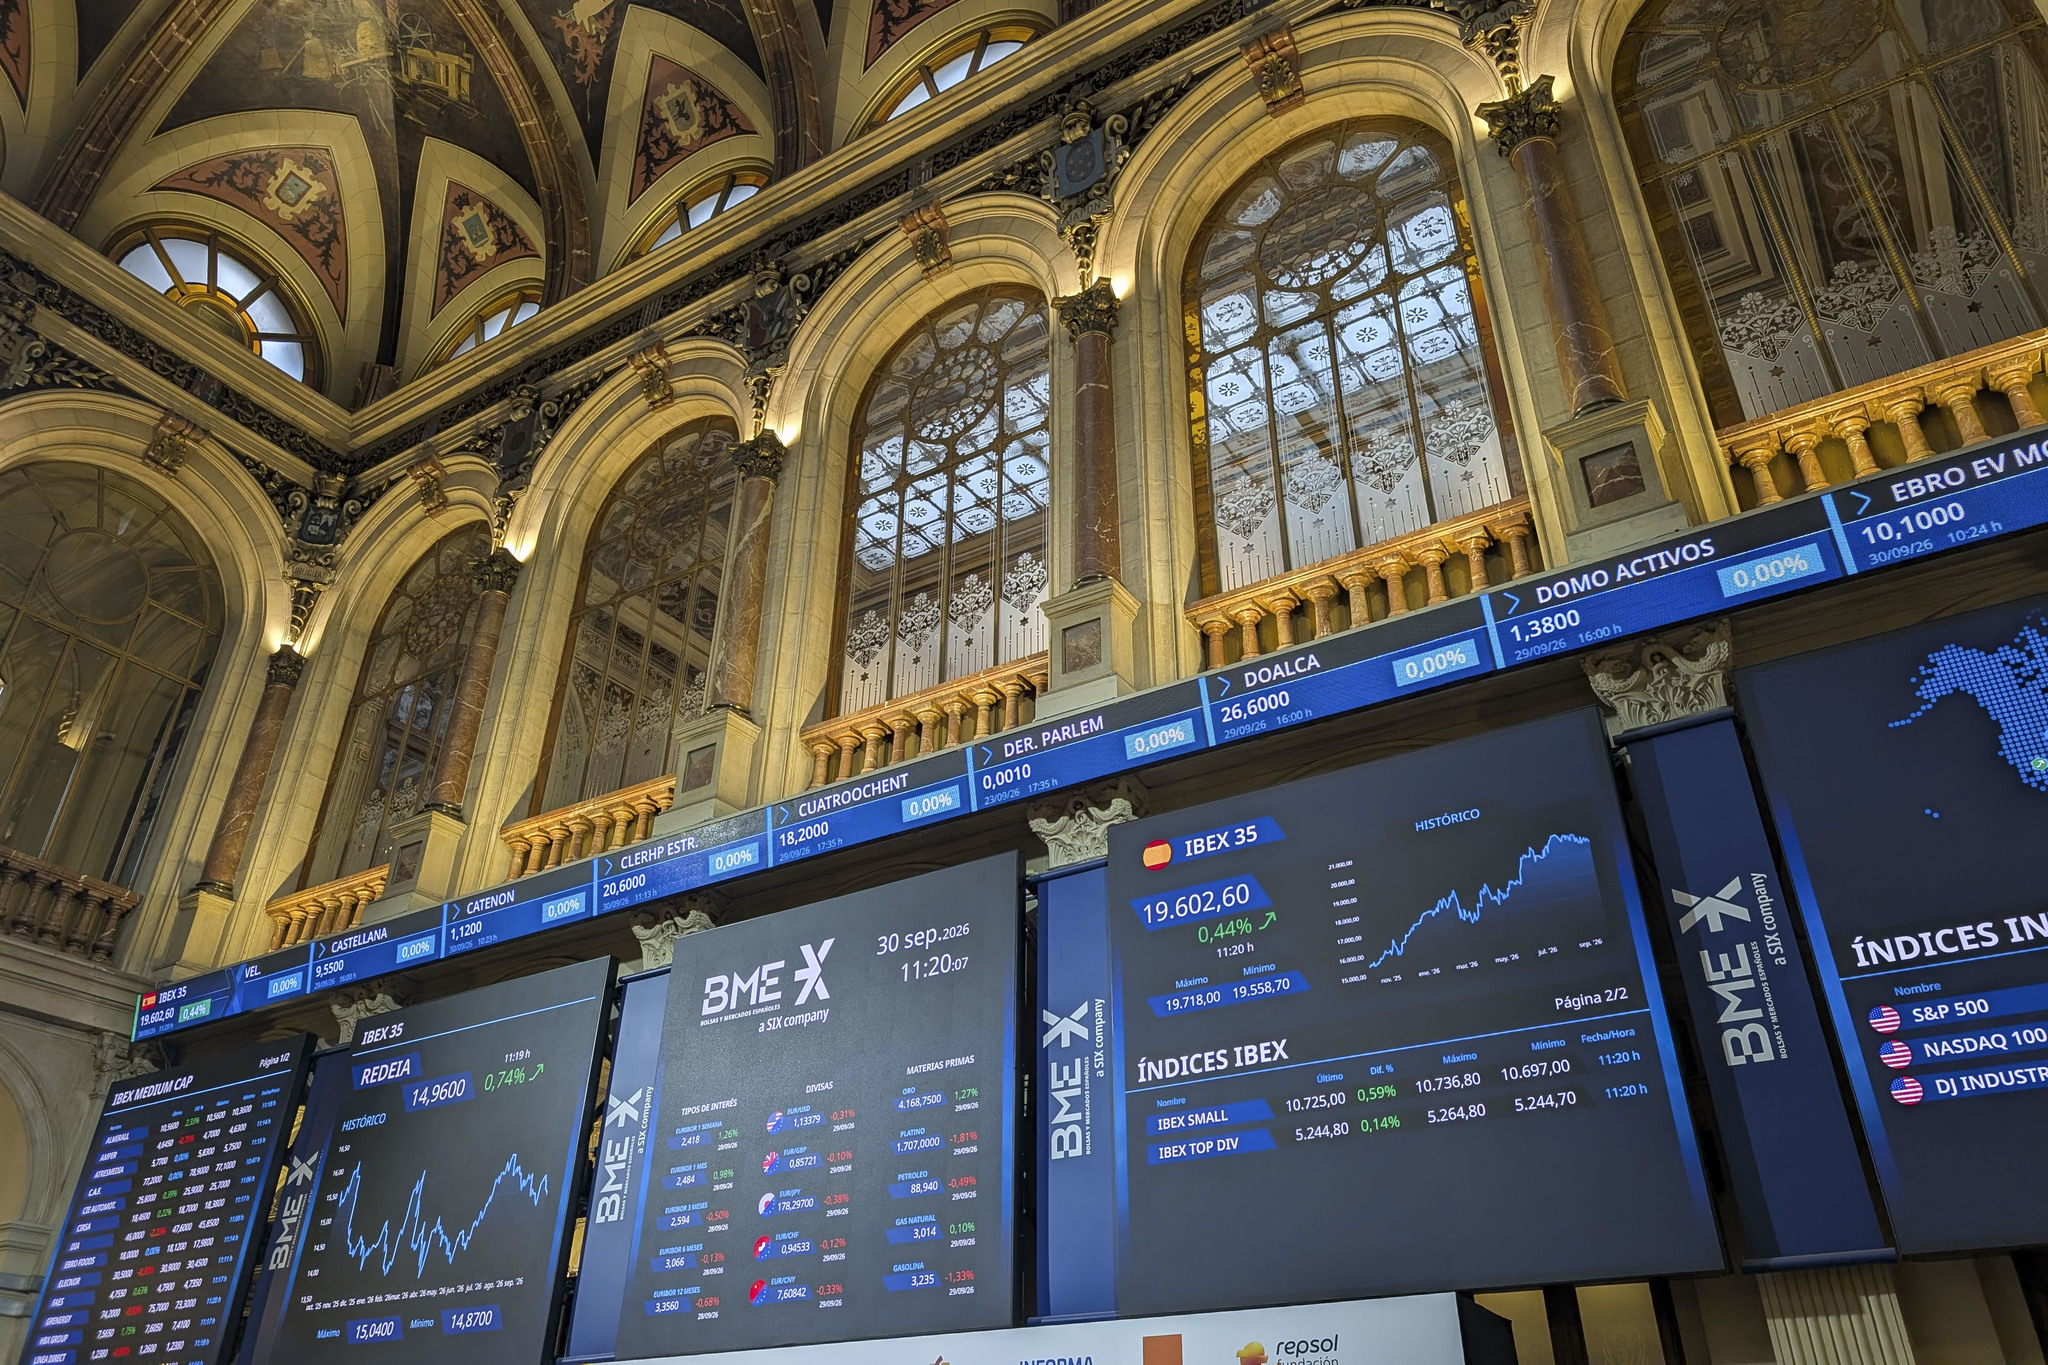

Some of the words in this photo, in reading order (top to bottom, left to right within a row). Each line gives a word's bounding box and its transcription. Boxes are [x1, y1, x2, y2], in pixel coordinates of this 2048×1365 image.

[1890, 468, 1966, 504] EBRO
[1972, 453, 2005, 479] EV
[1861, 502, 1965, 546] 10,1000
[1868, 538, 1934, 566] 30/09/26
[1947, 525, 1987, 545] 10:24
[1991, 521, 2003, 534] h
[1536, 570, 1610, 604] DOMO
[1614, 538, 1715, 582] ACTIVOS
[1732, 553, 1808, 588] 0,00%
[1510, 608, 1581, 643] 1,3800
[1514, 638, 1566, 661] 29/09/26
[1578, 626, 1610, 643] 16:00
[1244, 654, 1321, 688] DOALCA
[1404, 648, 1466, 680] 0,00%
[1220, 691, 1290, 723] 26,6000
[1224, 720, 1267, 740] 29/09/26
[1276, 710, 1303, 726] 16:00
[1004, 734, 1038, 758] DER.
[1041, 716, 1104, 748] PARLEM
[1134, 726, 1185, 753] 0,00%
[982, 764, 1032, 791] 0,0010
[798, 773, 910, 818] CUATROOCHENT
[910, 792, 952, 817] 0,00%
[984, 789, 1020, 806] 23/09/26
[1028, 781, 1049, 793] 17:35
[1414, 808, 1480, 832] HISTÓRICO
[779, 821, 829, 847] 18,2000
[1184, 831, 1230, 856] IBEX
[1234, 825, 1258, 845] 35
[620, 844, 664, 870] CLERHP
[668, 836, 698, 858] ESTR.
[715, 848, 752, 870] 0,00%
[603, 874, 646, 897] 20,6000
[466, 890, 515, 915] CATENON
[548, 898, 580, 918] 0,00%
[1143, 883, 1250, 924] 19.602,60
[1751, 872, 1776, 932] company
[331, 927, 388, 954] CASTELLANA
[450, 921, 482, 940] 1,1200
[1198, 917, 1252, 944] 0,44%
[402, 941, 430, 959] 0,00%
[876, 934, 899, 956] 30
[1216, 944, 1245, 958] 11:20
[1764, 932, 1784, 955] SIX
[1851, 921, 1998, 968] ÍNDICES
[316, 960, 344, 978] 9,5500
[901, 954, 968, 982] 11:20:07
[1242, 962, 1276, 976] Mínimo
[1751, 941, 1768, 980] ESPAÑOLES
[1775, 957, 1787, 966] a
[245, 966, 261, 978] VEL.
[1175, 975, 1208, 988] Máximo
[158, 989, 177, 1004] IBEX
[177, 986, 187, 999] 35
[272, 977, 298, 994] 0,00%
[702, 960, 785, 1016] BME
[1232, 977, 1290, 999] 19.558,70
[1894, 981, 1942, 996] Nombre
[1165, 990, 1221, 1012] 19.718,00
[1554, 991, 1602, 1010] Página
[1604, 987, 1628, 1002] 2/2
[1700, 943, 1775, 1066] BME
[1762, 981, 1778, 1023] MERCADOS
[140, 1008, 174, 1026] 19.602,60
[182, 1004, 206, 1020] 0,44%
[700, 1017, 718, 1026] BOLSAS
[724, 1010, 751, 1022] MERCADOS
[752, 1004, 780, 1015] ESPAÑOLES
[758, 1022, 764, 1032] a
[766, 1018, 782, 1031] SIX
[784, 1007, 829, 1028] company
[1912, 1004, 1950, 1023] S&P
[1954, 999, 1989, 1016] 500
[361, 1026, 388, 1044] IBEX
[388, 1023, 404, 1038] 35
[1094, 998, 1105, 1048] company
[1530, 1038, 1566, 1052] Mínimo
[1580, 1027, 1636, 1044] Fecha/Hora
[1774, 1030, 1788, 1059] BOLSAS
[1924, 1033, 2008, 1058] NASDAQ
[2011, 1027, 2048, 1046] 100
[259, 1056, 279, 1068] Página
[280, 1053, 290, 1062] 1/2
[504, 1050, 524, 1063] 11:19
[906, 1060, 944, 1075] MATERIAS
[945, 1055, 974, 1068] PRIMAS
[1094, 1050, 1104, 1068] SIX
[1138, 1050, 1228, 1084] ÍNDICES
[1234, 1039, 1289, 1067] IBEX
[1442, 1051, 1477, 1064] Máximo
[1598, 1052, 1630, 1066] 11:20
[360, 1058, 411, 1085] REDEIA
[484, 1068, 525, 1091] 0,74%
[1316, 1072, 1343, 1084] Último
[1370, 1064, 1383, 1076] Dif.
[1385, 1064, 1394, 1073] %
[1501, 1059, 1570, 1082] 10.697,00
[112, 1089, 137, 1106] IBEX
[135, 1081, 173, 1101] MEDIUM
[174, 1075, 193, 1090] CAP
[412, 1078, 466, 1106] 14,9600
[806, 1082, 833, 1094] DIVISAS
[1357, 1084, 1396, 1102] 0,59%
[1415, 1072, 1481, 1094] 10.736,80
[1604, 1084, 1636, 1099] 11:20
[1935, 1078, 1958, 1096] DJ
[641, 1086, 654, 1128] company
[681, 1107, 700, 1116] TIPOS
[710, 1099, 738, 1110] INTERÉS
[898, 1094, 942, 1109] 4.168,7500
[1051, 1058, 1082, 1160] BME
[1156, 1096, 1186, 1108] Nombre
[1286, 1092, 1346, 1112] 10.725,00
[1514, 1091, 1576, 1113] 5.244,70
[342, 1113, 386, 1132] HISTÓRICO
[1158, 1115, 1186, 1131] IBEX
[1188, 1110, 1228, 1126] SMALL
[1360, 1116, 1400, 1132] 0,14%
[1427, 1102, 1486, 1124] 5.264,80
[638, 1129, 647, 1144] SIX
[1296, 1122, 1349, 1142] 5.244,80
[896, 1137, 940, 1152] 1.707,0000
[1158, 1144, 1186, 1160] IBEX
[1188, 1141, 1214, 1156] TOP
[1217, 1138, 1239, 1152] DIV
[596, 1136, 630, 1224] BME
[898, 1170, 928, 1181] PETROLEO
[948, 1176, 976, 1188] -0,49%
[910, 1180, 938, 1194] 88,940
[778, 1198, 814, 1212] 178,29700
[269, 1194, 303, 1270] BME
[670, 1216, 690, 1226] 2,594
[949, 1222, 975, 1234] 0,10%
[913, 1226, 936, 1239] 3,014
[781, 1242, 810, 1254] 0,94533
[893, 1262, 924, 1272] GASOLINA
[944, 1270, 974, 1282] -1,33%
[911, 1274, 934, 1286] 3,235
[777, 1287, 806, 1300] 7,60842
[655, 1301, 679, 1312] 3,3560
[355, 1322, 394, 1340] 15,0400
[410, 1317, 434, 1328] Mínimo
[450, 1310, 492, 1330] 14,8700
[317, 1327, 340, 1339] Máximo
[1276, 1334, 1338, 1358] repsol
